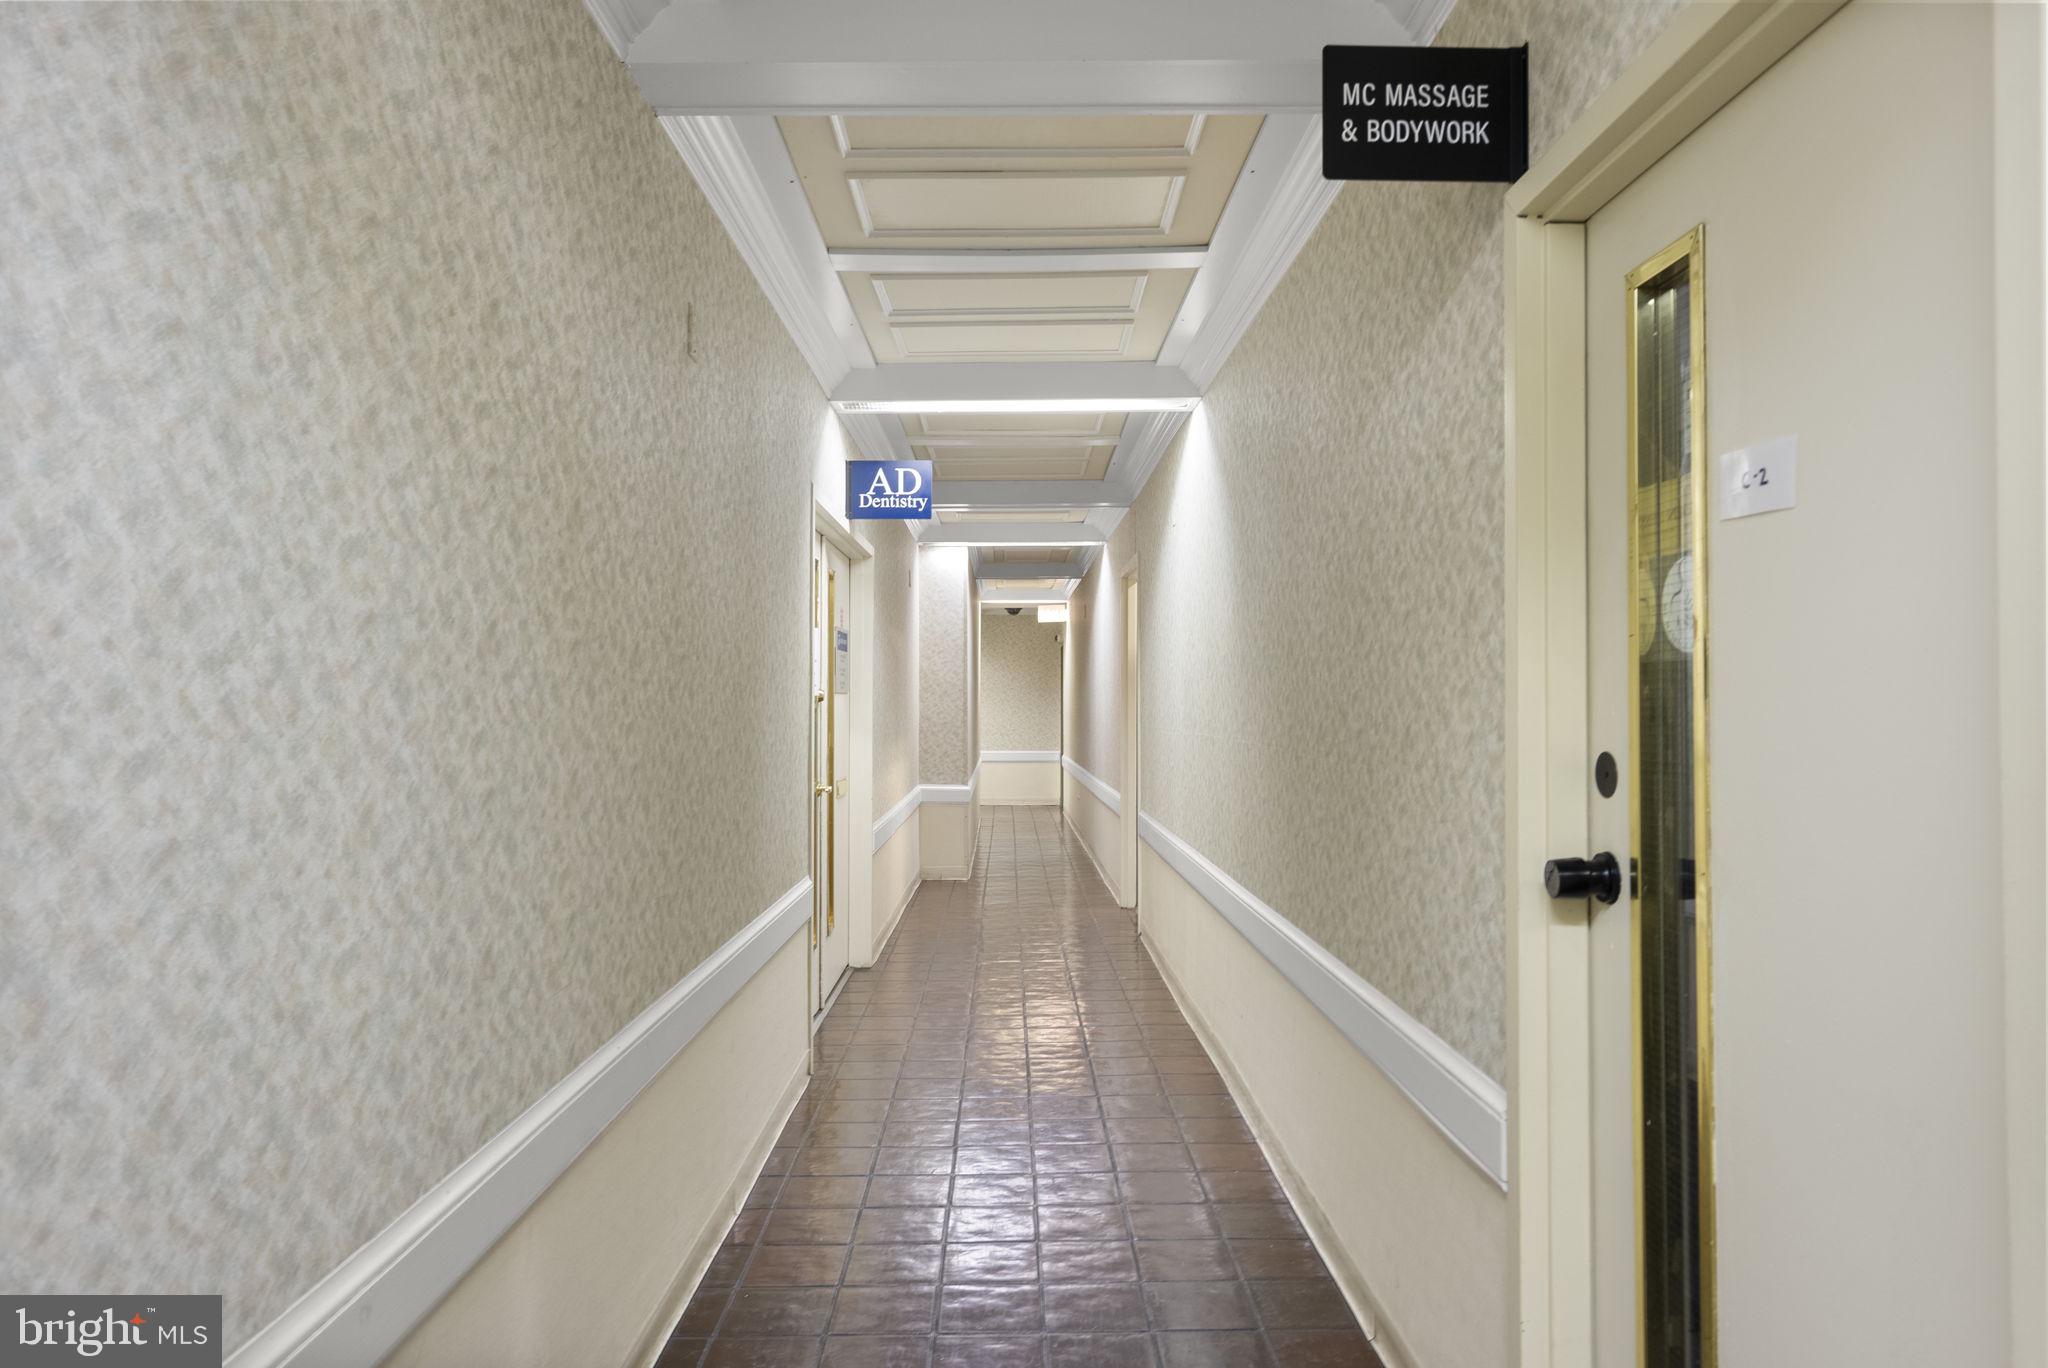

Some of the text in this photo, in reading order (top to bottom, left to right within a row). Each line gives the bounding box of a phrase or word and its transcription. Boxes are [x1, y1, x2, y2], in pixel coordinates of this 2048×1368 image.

[1342, 82, 1490, 108] MC MASSAGE
[1341, 118, 1491, 145] & BODYWORK
[866, 467, 922, 495] AD
[1741, 466, 1769, 489] C-2
[858, 493, 928, 512] Dentistry
